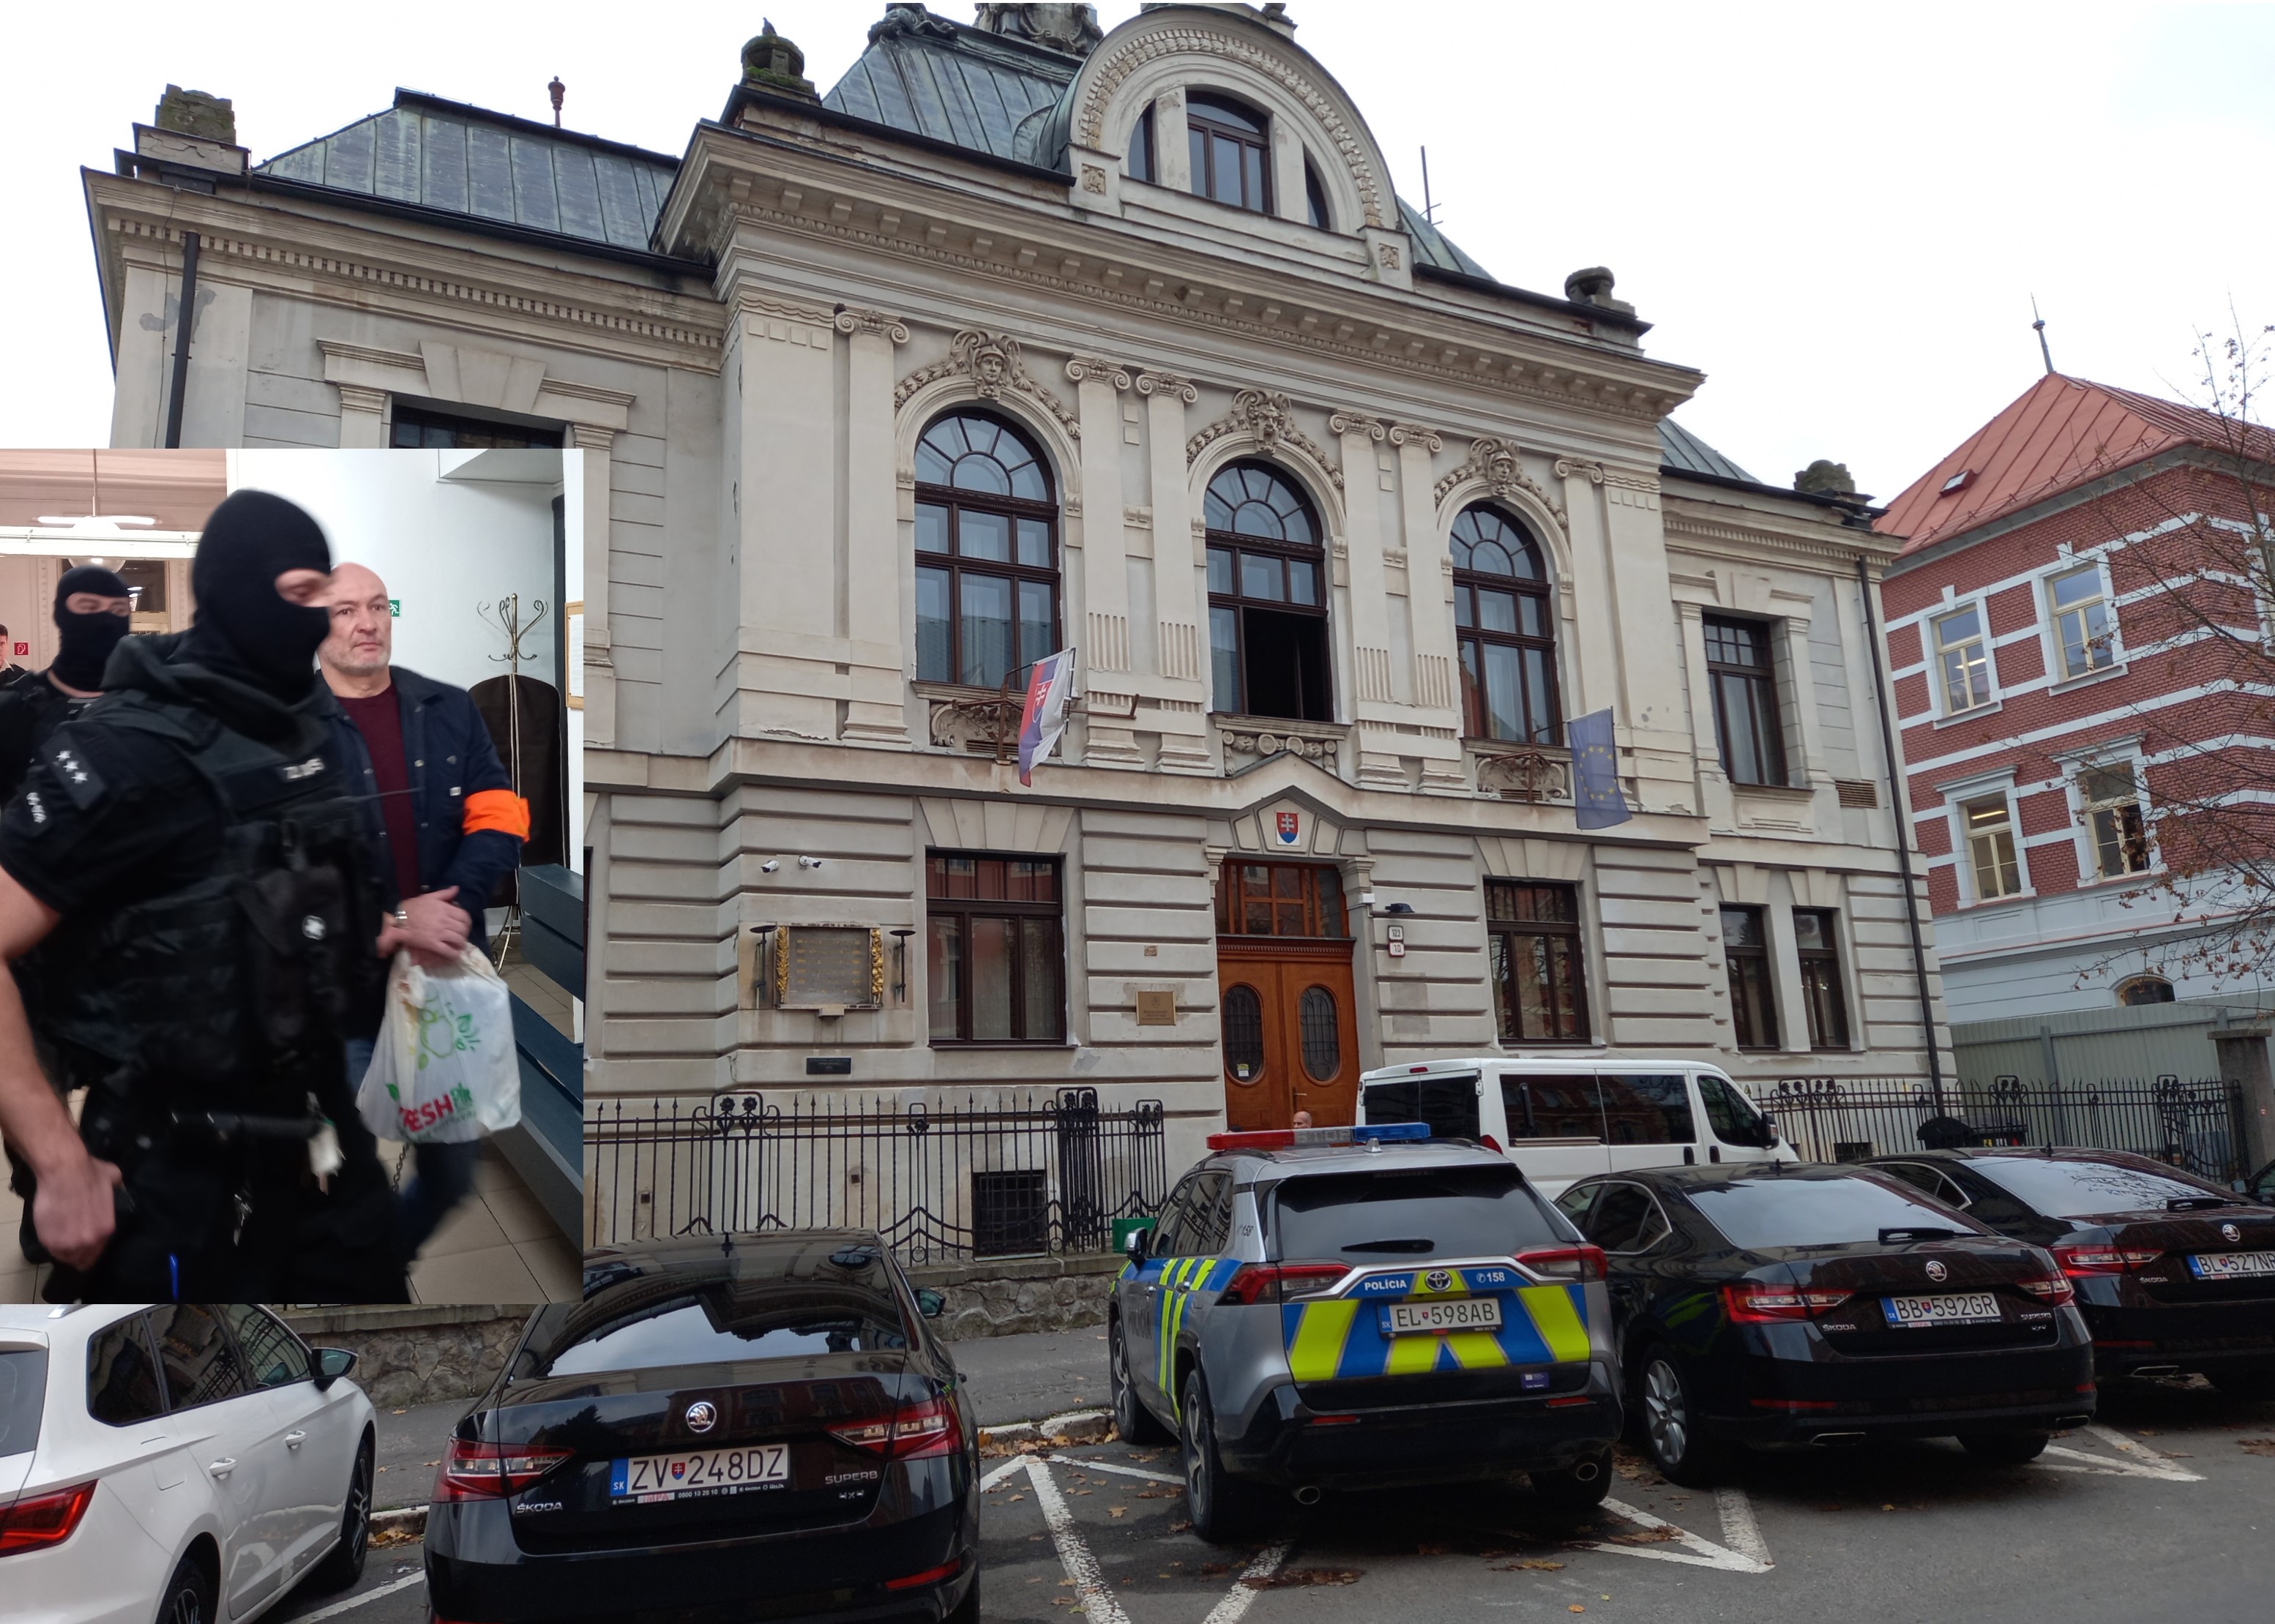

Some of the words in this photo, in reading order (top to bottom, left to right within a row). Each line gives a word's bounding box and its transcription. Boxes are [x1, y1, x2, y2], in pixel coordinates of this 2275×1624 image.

[1394, 944, 1401, 953] 10
[2198, 1256, 2223, 1273] BL
[1487, 1272, 1506, 1283] 158
[1364, 1279, 1407, 1291] POLÍCIA
[1895, 1299, 1923, 1320] BB
[1930, 1295, 1997, 1317] 592GR
[1396, 1308, 1421, 1328] EL
[1431, 1303, 1495, 1325] 598AB
[631, 1458, 669, 1492] ZV
[687, 1448, 783, 1486] 248DZ
[825, 1470, 878, 1484] SUPERB
[613, 1481, 625, 1491] SK
[516, 1502, 563, 1513] ŠKODA
